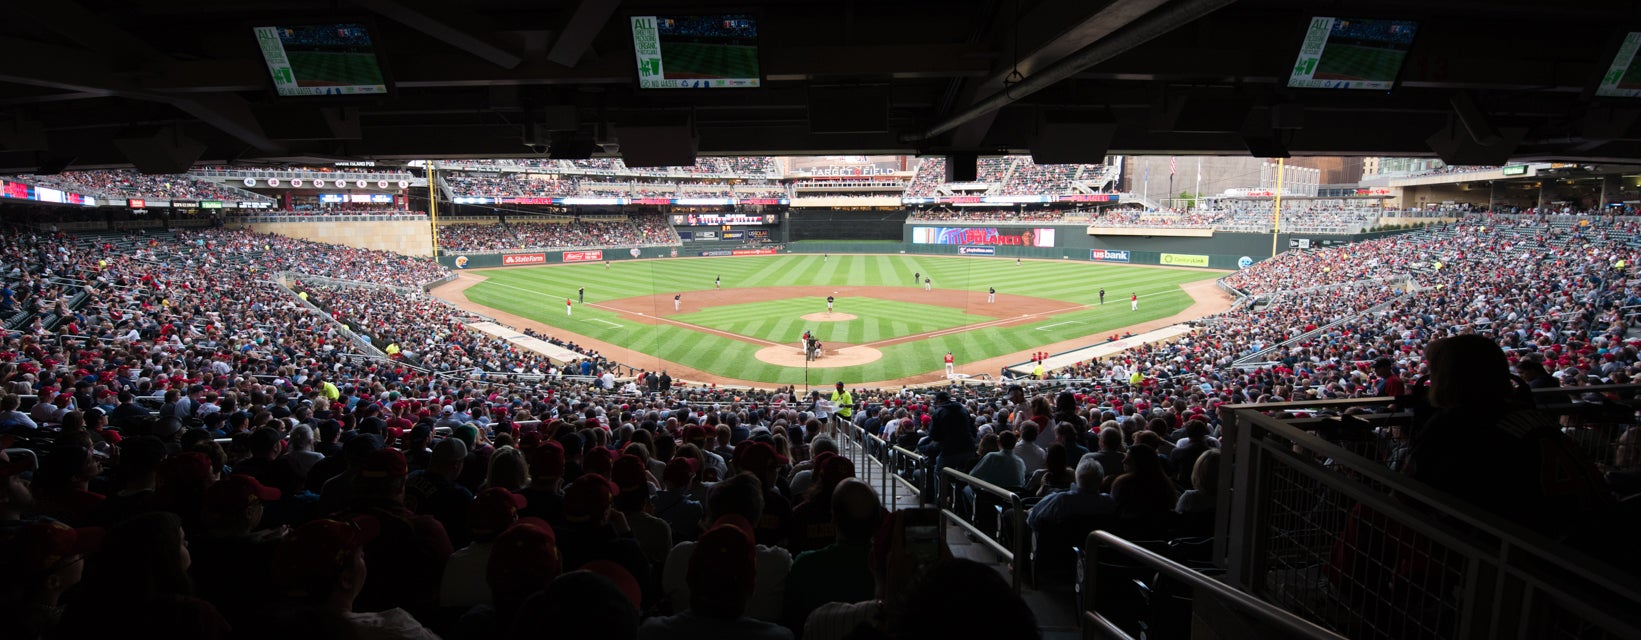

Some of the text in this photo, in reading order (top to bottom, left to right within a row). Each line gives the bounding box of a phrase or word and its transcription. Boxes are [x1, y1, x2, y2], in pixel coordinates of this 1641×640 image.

[635, 19, 655, 29] ALL
[258, 29, 277, 39] ALL
[965, 235, 1021, 245] POLANCO
